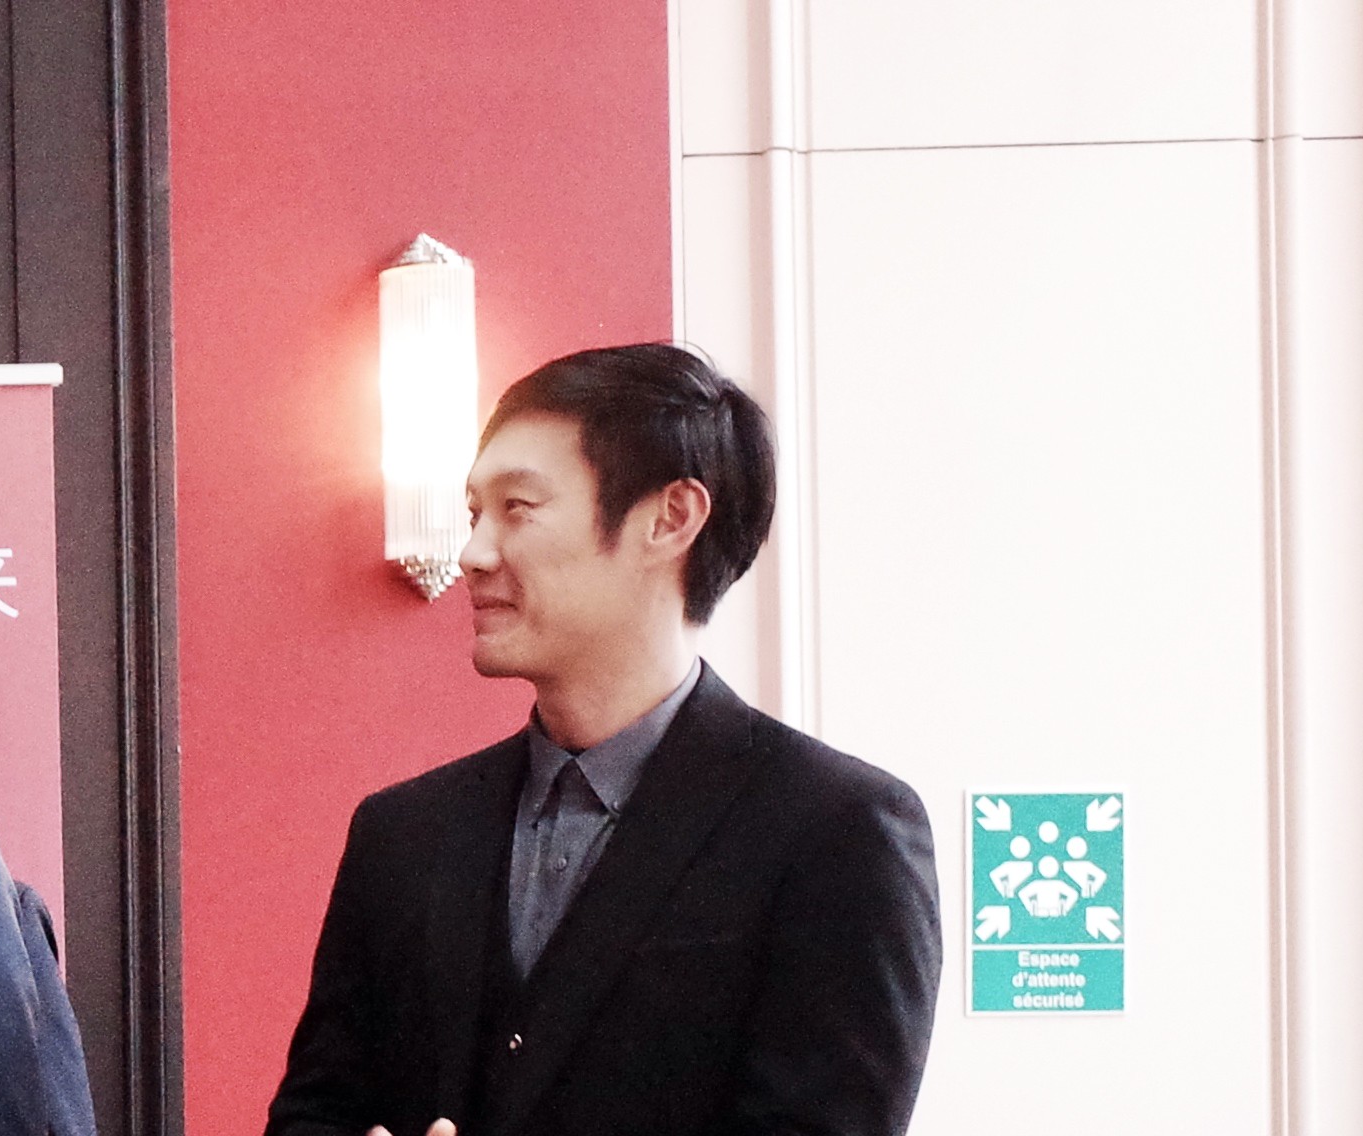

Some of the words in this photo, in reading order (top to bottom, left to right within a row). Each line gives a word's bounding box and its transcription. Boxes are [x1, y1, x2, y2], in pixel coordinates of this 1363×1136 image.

[1018, 951, 1080, 968] Espace
[1012, 972, 1086, 987] d'attente
[1013, 992, 1085, 1008] sécurisé
